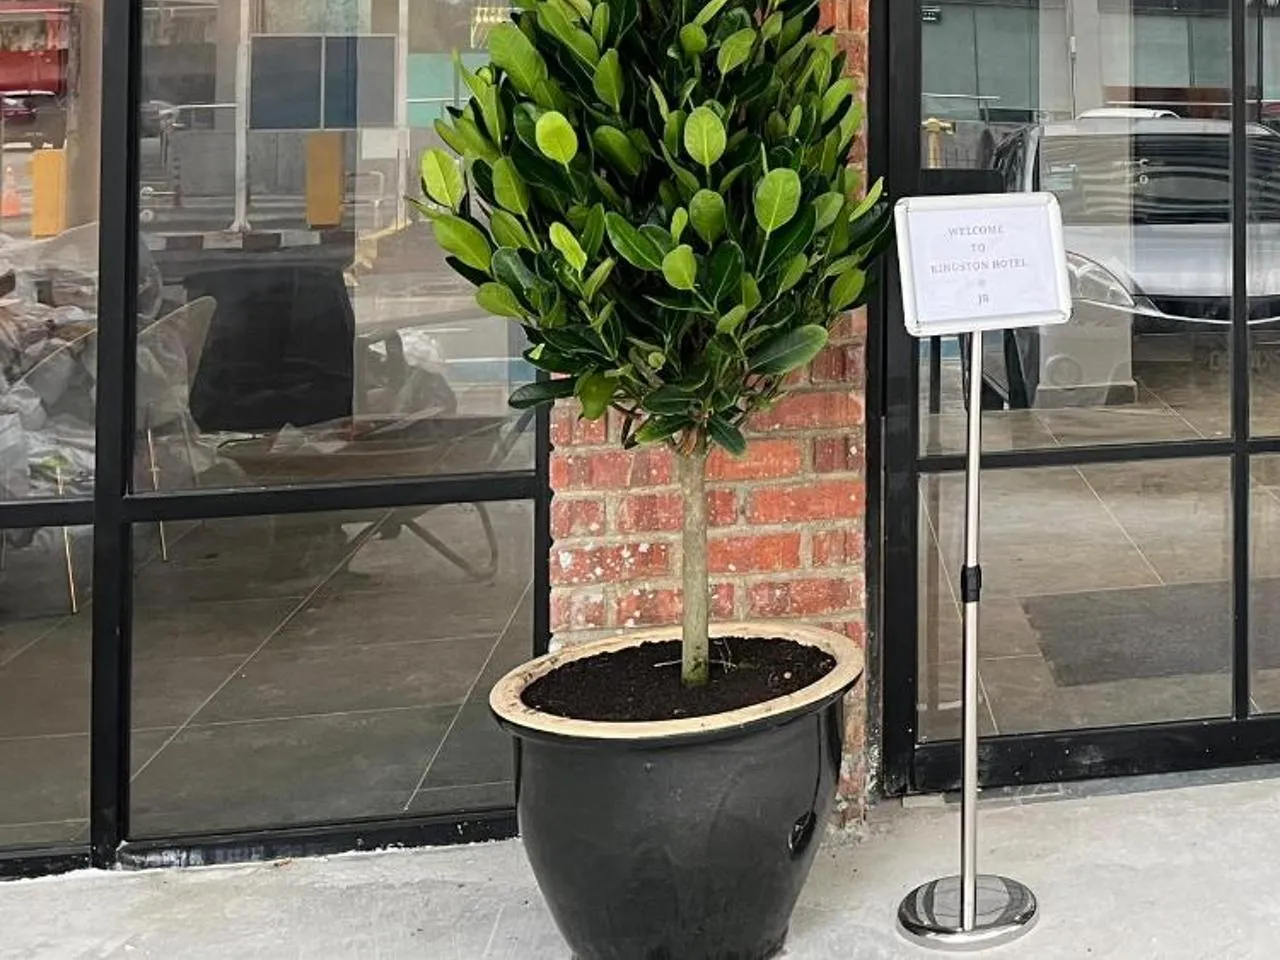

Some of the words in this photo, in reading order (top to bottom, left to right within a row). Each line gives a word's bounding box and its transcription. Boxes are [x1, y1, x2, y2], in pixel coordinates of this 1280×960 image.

[948, 225, 1005, 236] WELCOME
[971, 242, 986, 253] TO
[931, 261, 989, 274] KINGSTON
[993, 258, 1026, 269] HOTEL
